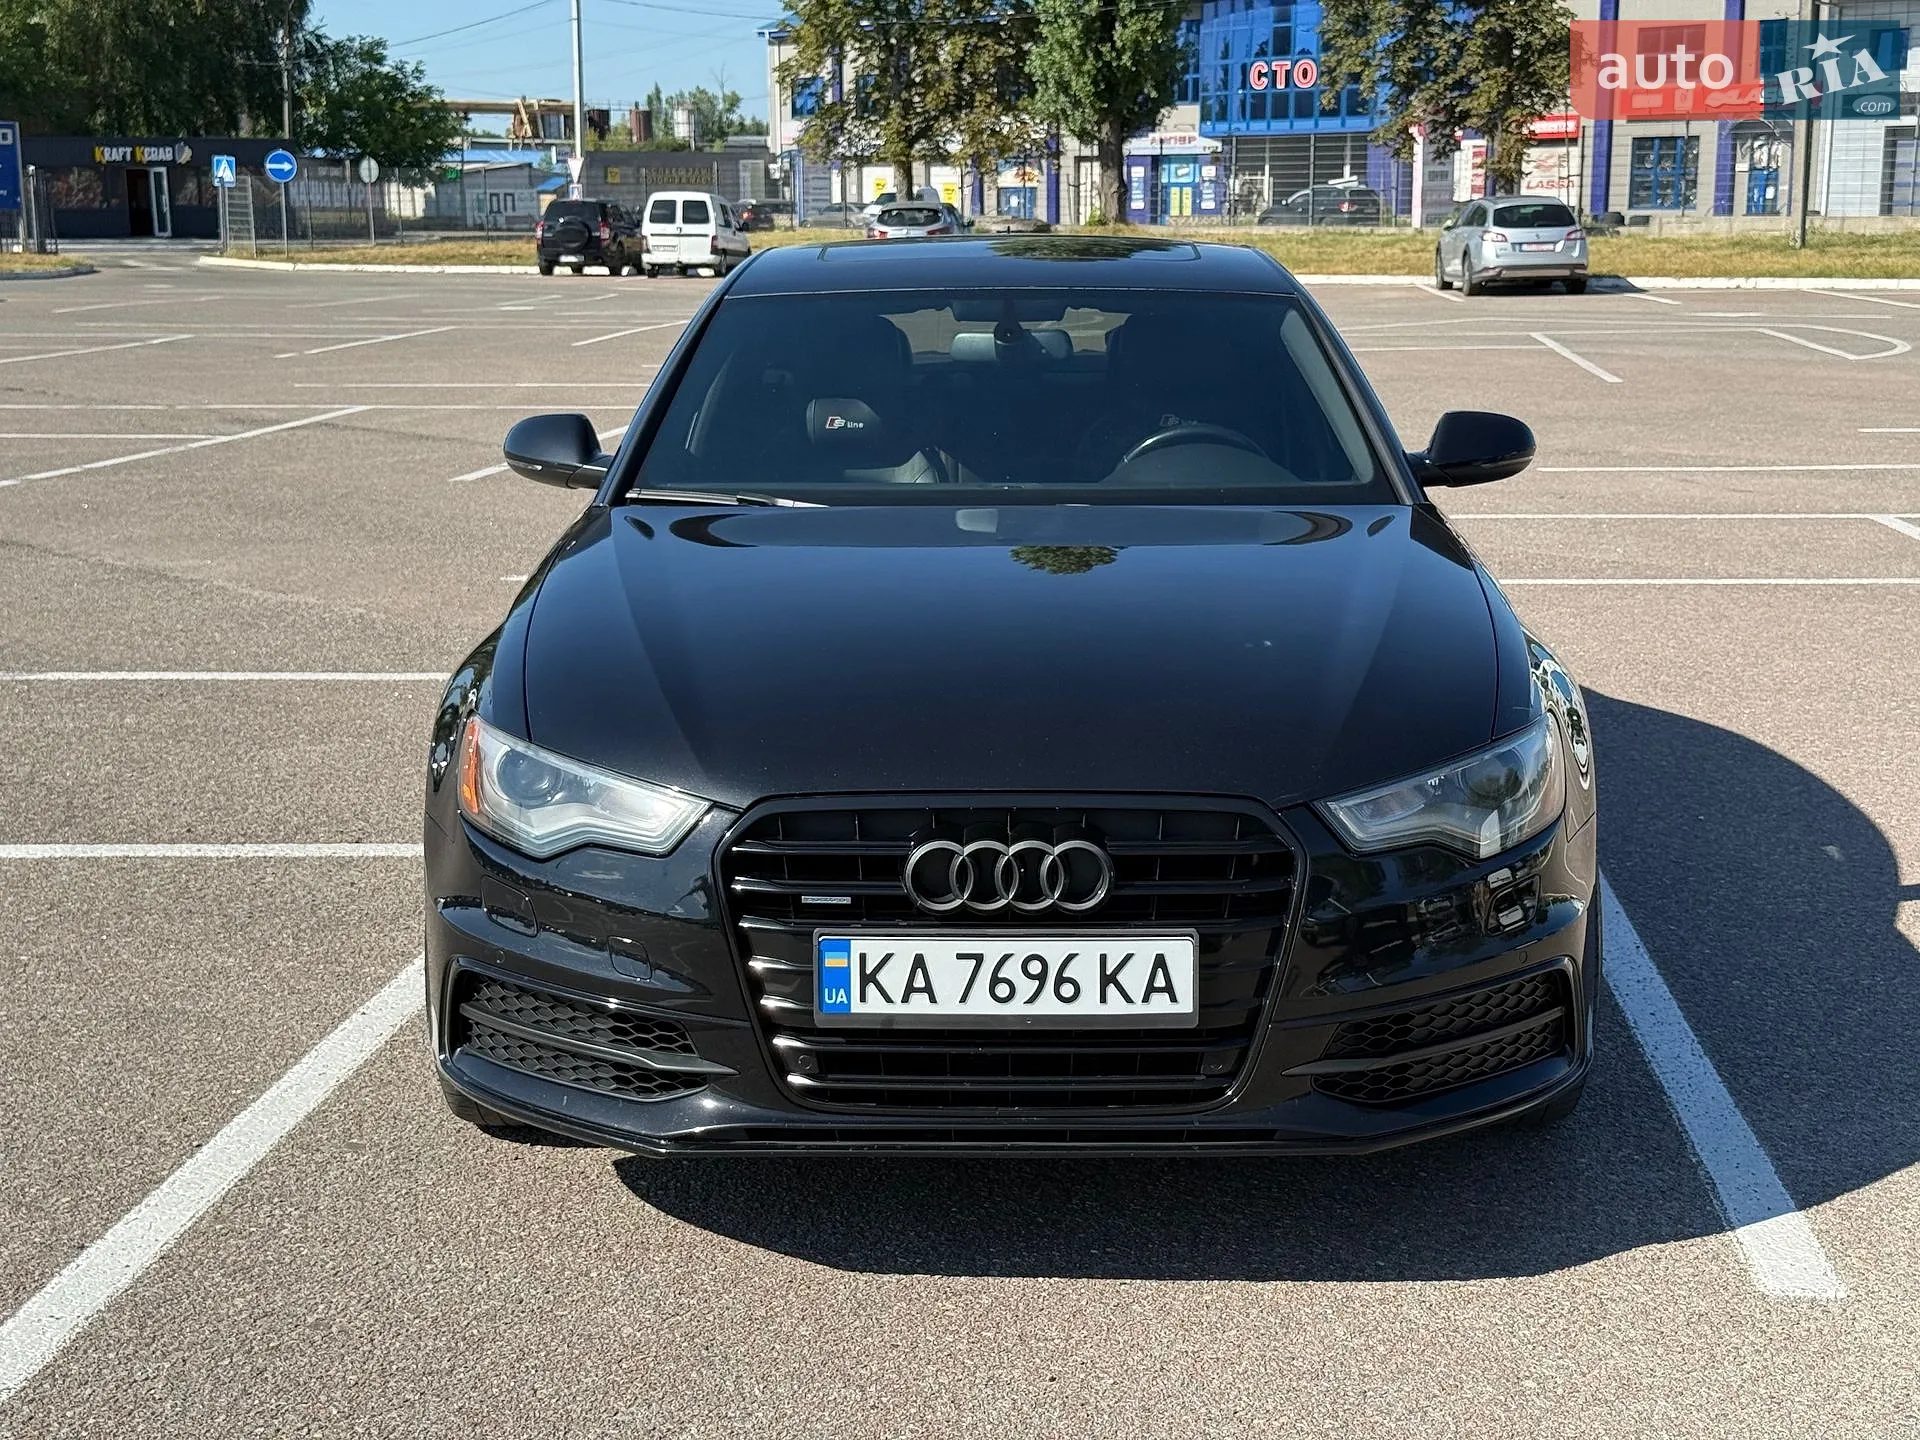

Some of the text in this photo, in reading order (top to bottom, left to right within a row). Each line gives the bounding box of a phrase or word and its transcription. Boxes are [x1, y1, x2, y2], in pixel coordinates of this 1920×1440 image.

[1249, 58, 1318, 91] СТО
[95, 146, 132, 164] KRAFT
[859, 952, 1179, 1004] KA 7696 KA
[824, 988, 849, 1005] UA
